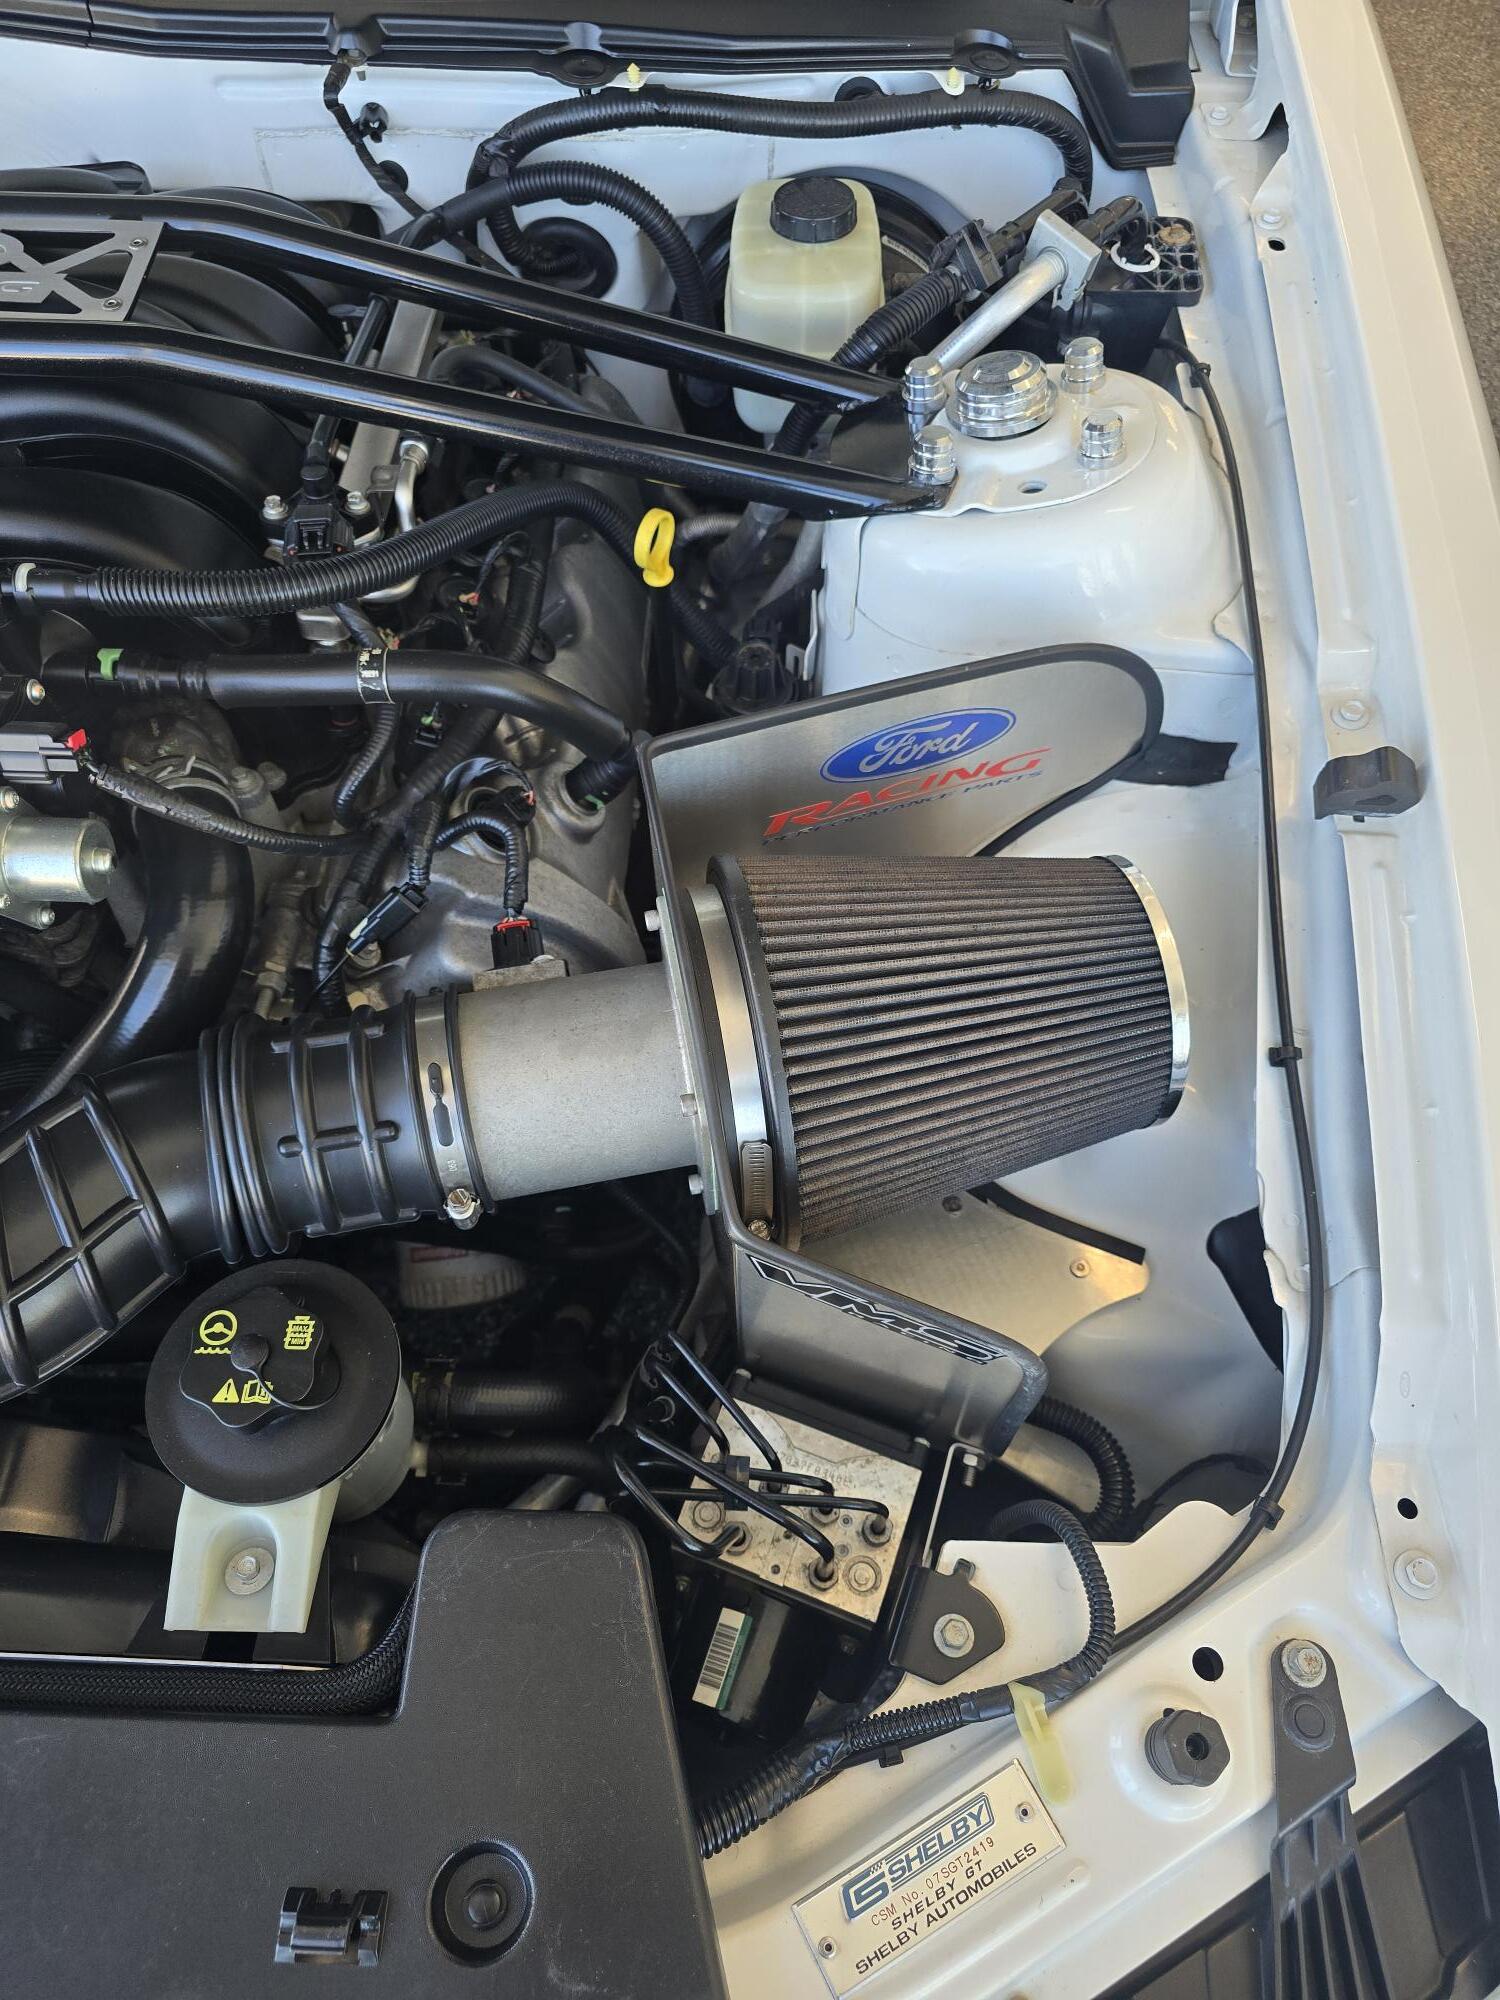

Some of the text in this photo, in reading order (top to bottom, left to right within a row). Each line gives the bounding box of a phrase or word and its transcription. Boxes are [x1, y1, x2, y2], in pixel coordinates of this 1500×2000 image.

[858, 720, 979, 773] Ford
[963, 769, 1044, 794] PARTS
[763, 747, 1052, 837] RACING
[871, 1836, 995, 1927] CSM No. 07SGT2419
[888, 1804, 985, 1883] SHELBY
[855, 1842, 1038, 1975] SHELBY AUTOMOBILES
[891, 1859, 983, 1931] SHELBY GT
